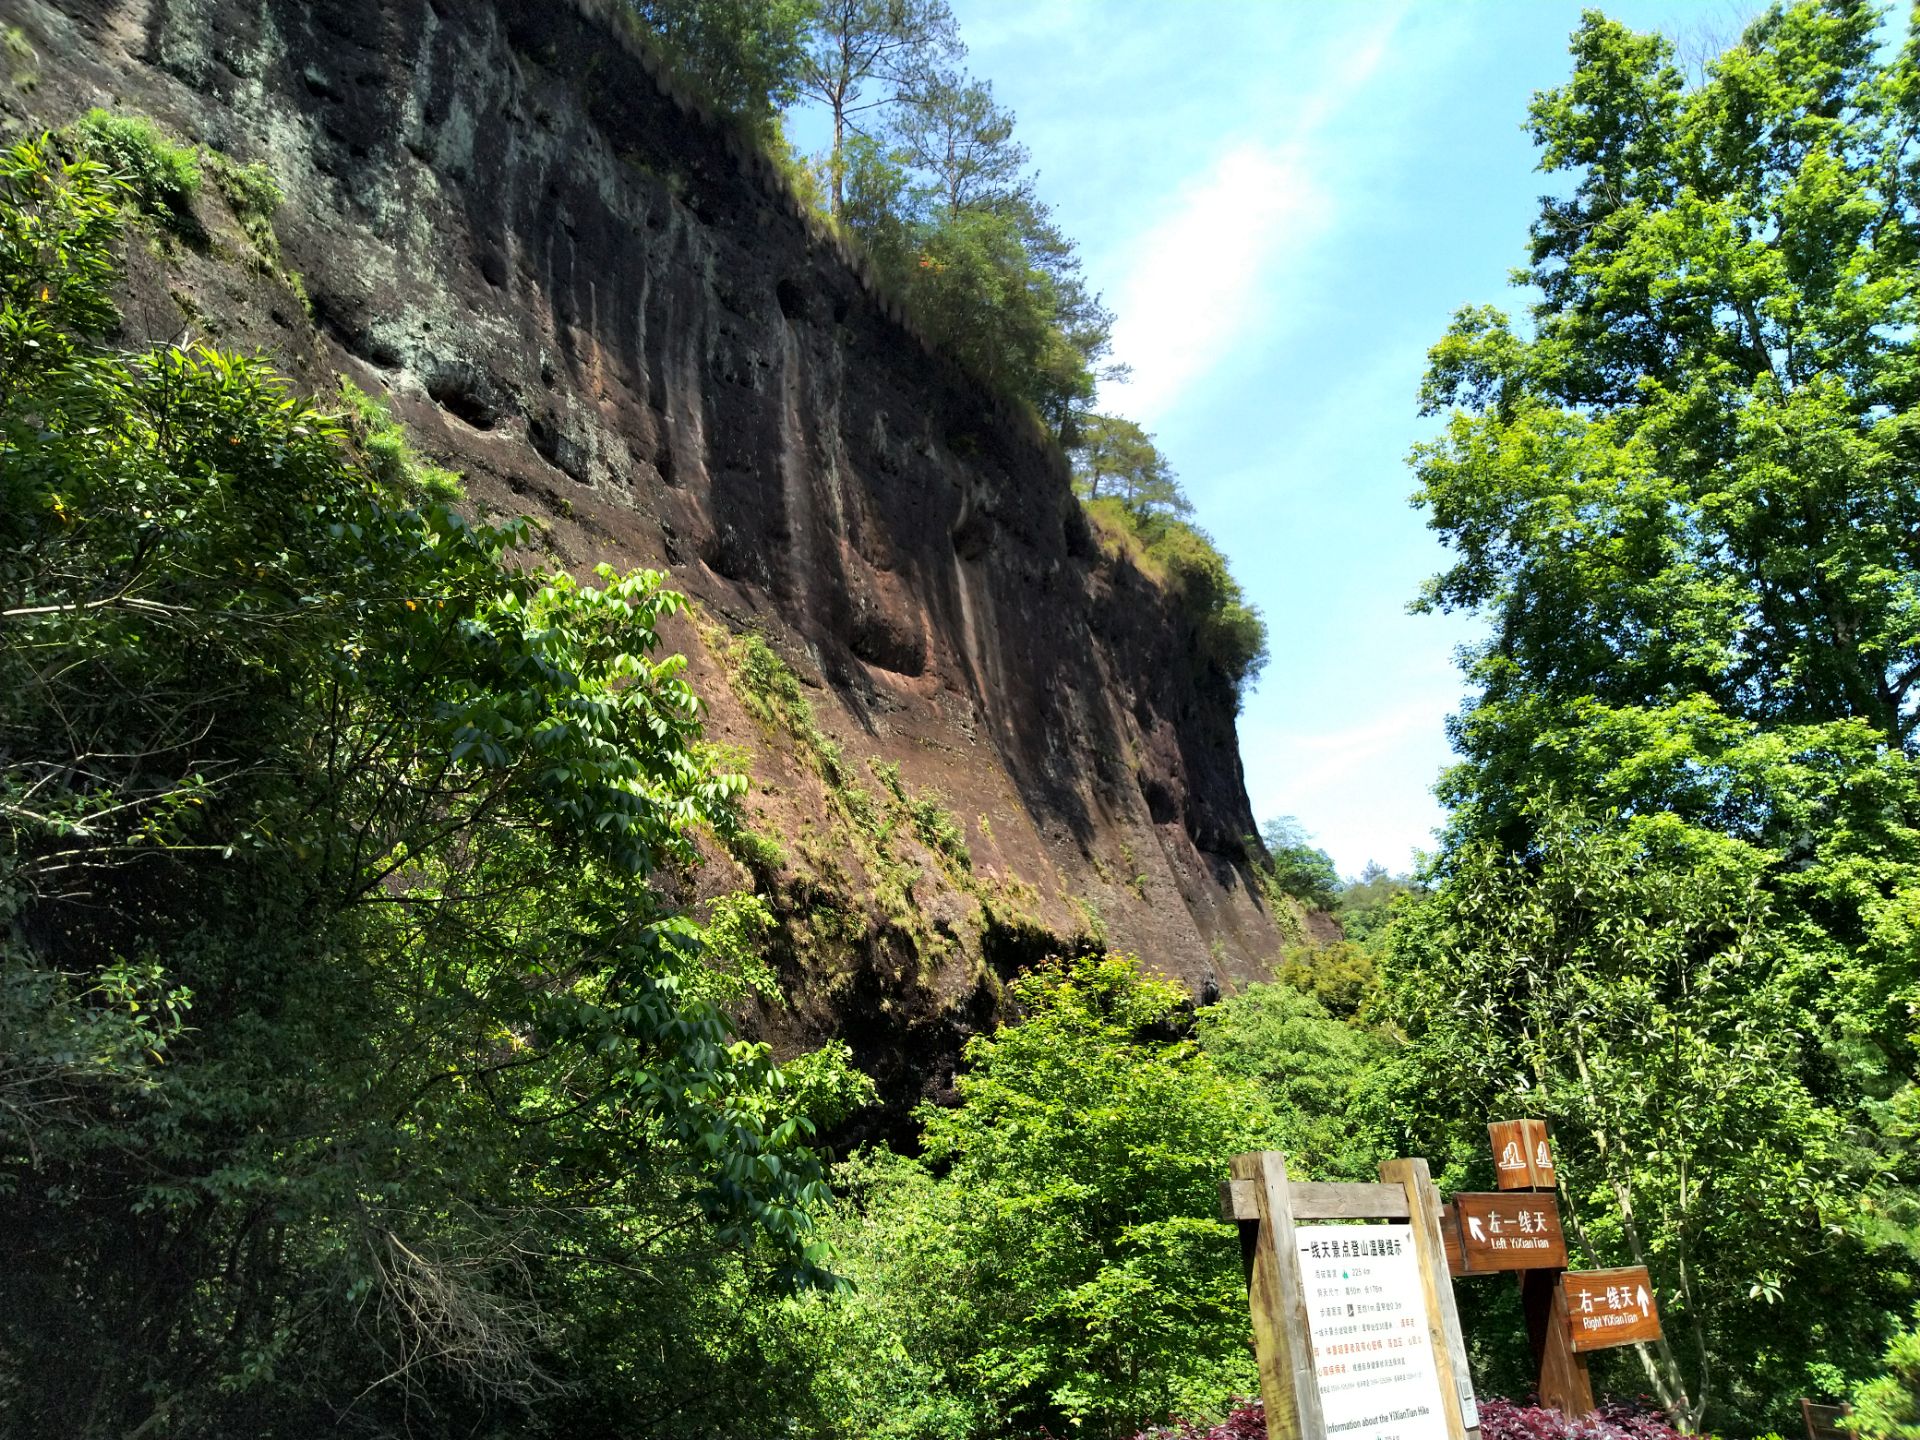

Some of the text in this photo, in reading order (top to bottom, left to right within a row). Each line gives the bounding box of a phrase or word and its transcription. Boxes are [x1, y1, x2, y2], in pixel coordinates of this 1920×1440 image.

[1488, 1210, 1548, 1234] 左一线天
[1301, 1239, 1402, 1259] 一线天景点登山温馨提示
[1490, 1236, 1549, 1250] Left YiXianTian
[1579, 1285, 1634, 1314] 右一线天
[1583, 1313, 1639, 1331] Right YiXianTian
[1326, 1405, 1430, 1434] Information about the YiXianTian Hike
